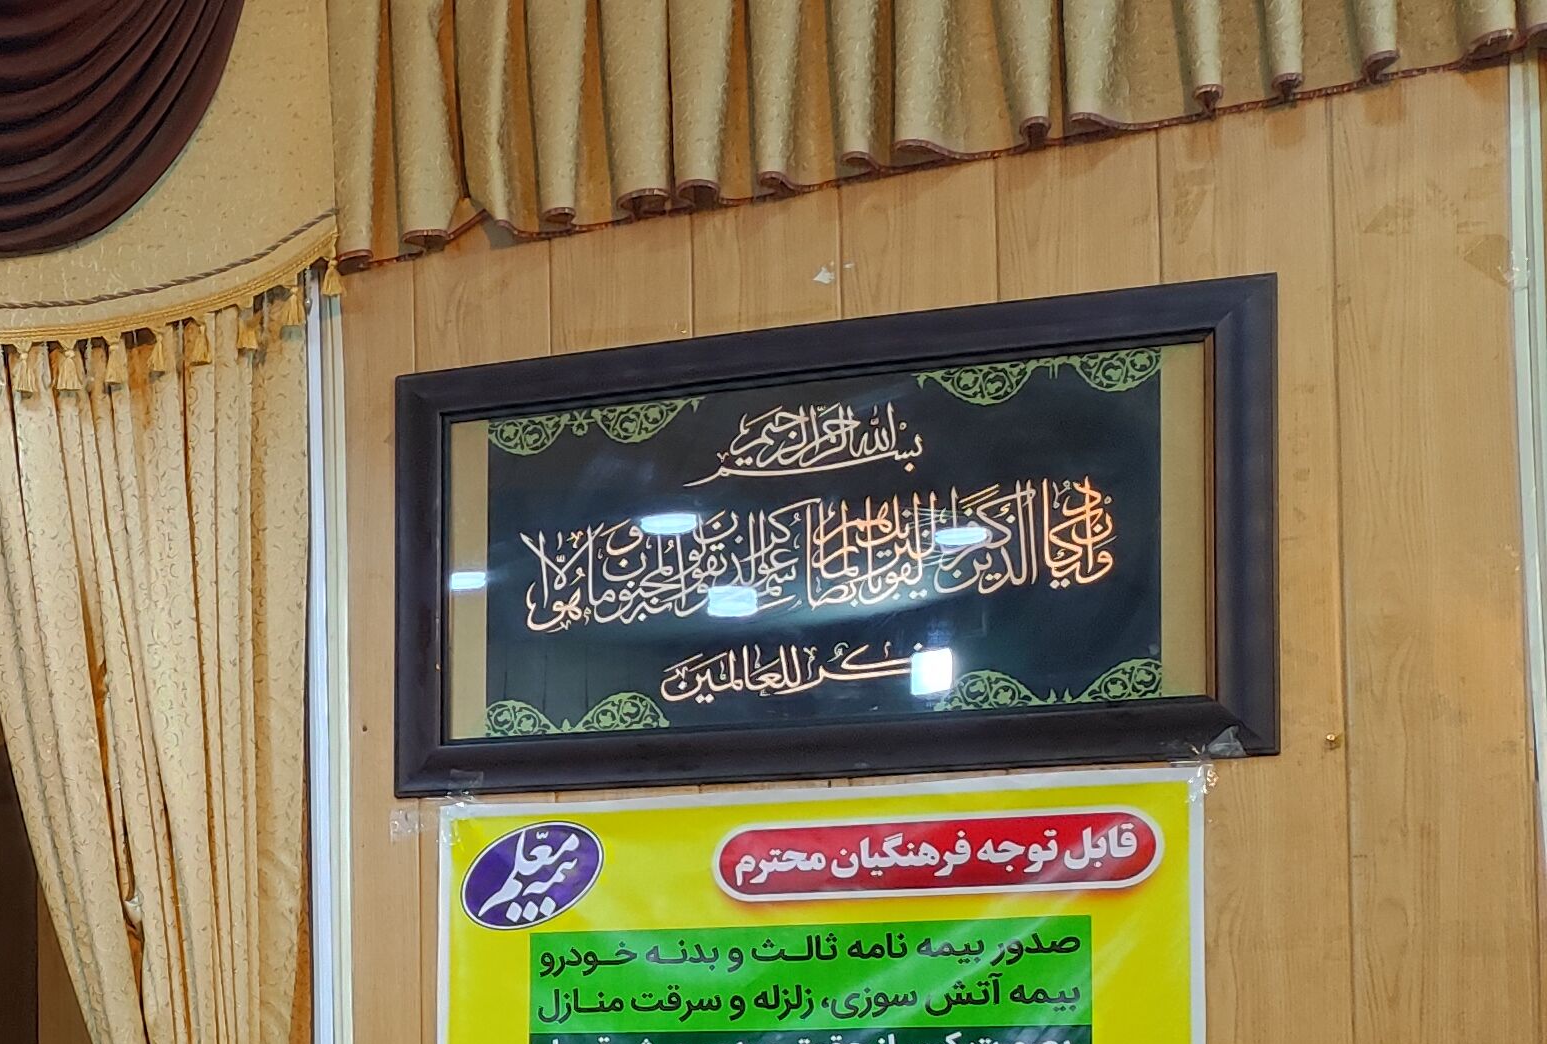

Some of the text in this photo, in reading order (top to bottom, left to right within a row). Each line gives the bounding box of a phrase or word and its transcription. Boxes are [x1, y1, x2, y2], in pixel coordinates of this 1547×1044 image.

[735, 823, 1137, 886] قابل توجه فرهنگیان محترم
[540, 933, 1080, 977] صدور بیمه نامه ثالث و بدنه خودرو
[538, 973, 1080, 1024] بیمه آتش سوزی، زلزله و سرقت منازل
